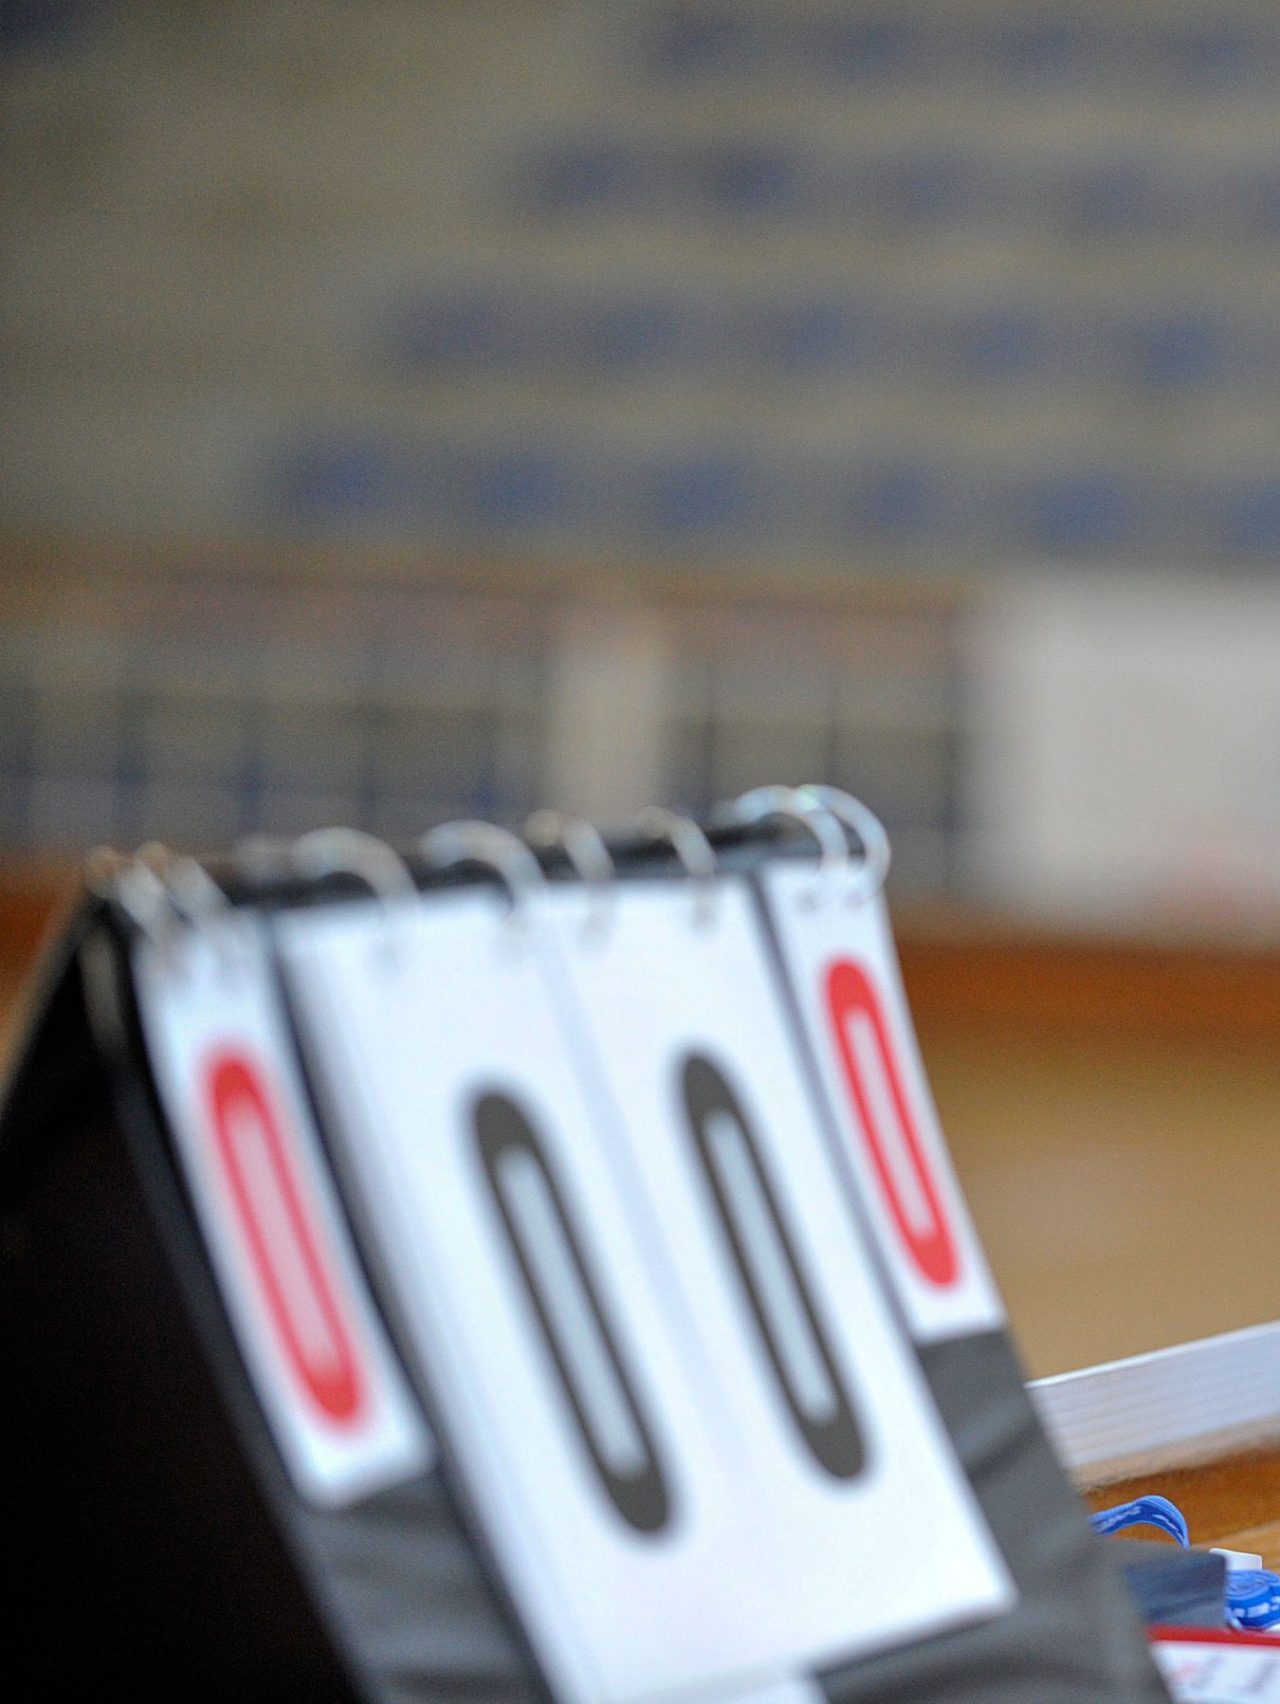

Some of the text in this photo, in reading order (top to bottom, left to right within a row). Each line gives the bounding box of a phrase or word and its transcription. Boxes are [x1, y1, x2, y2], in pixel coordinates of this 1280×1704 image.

[202, 956, 962, 1543] 0 0 0 0
